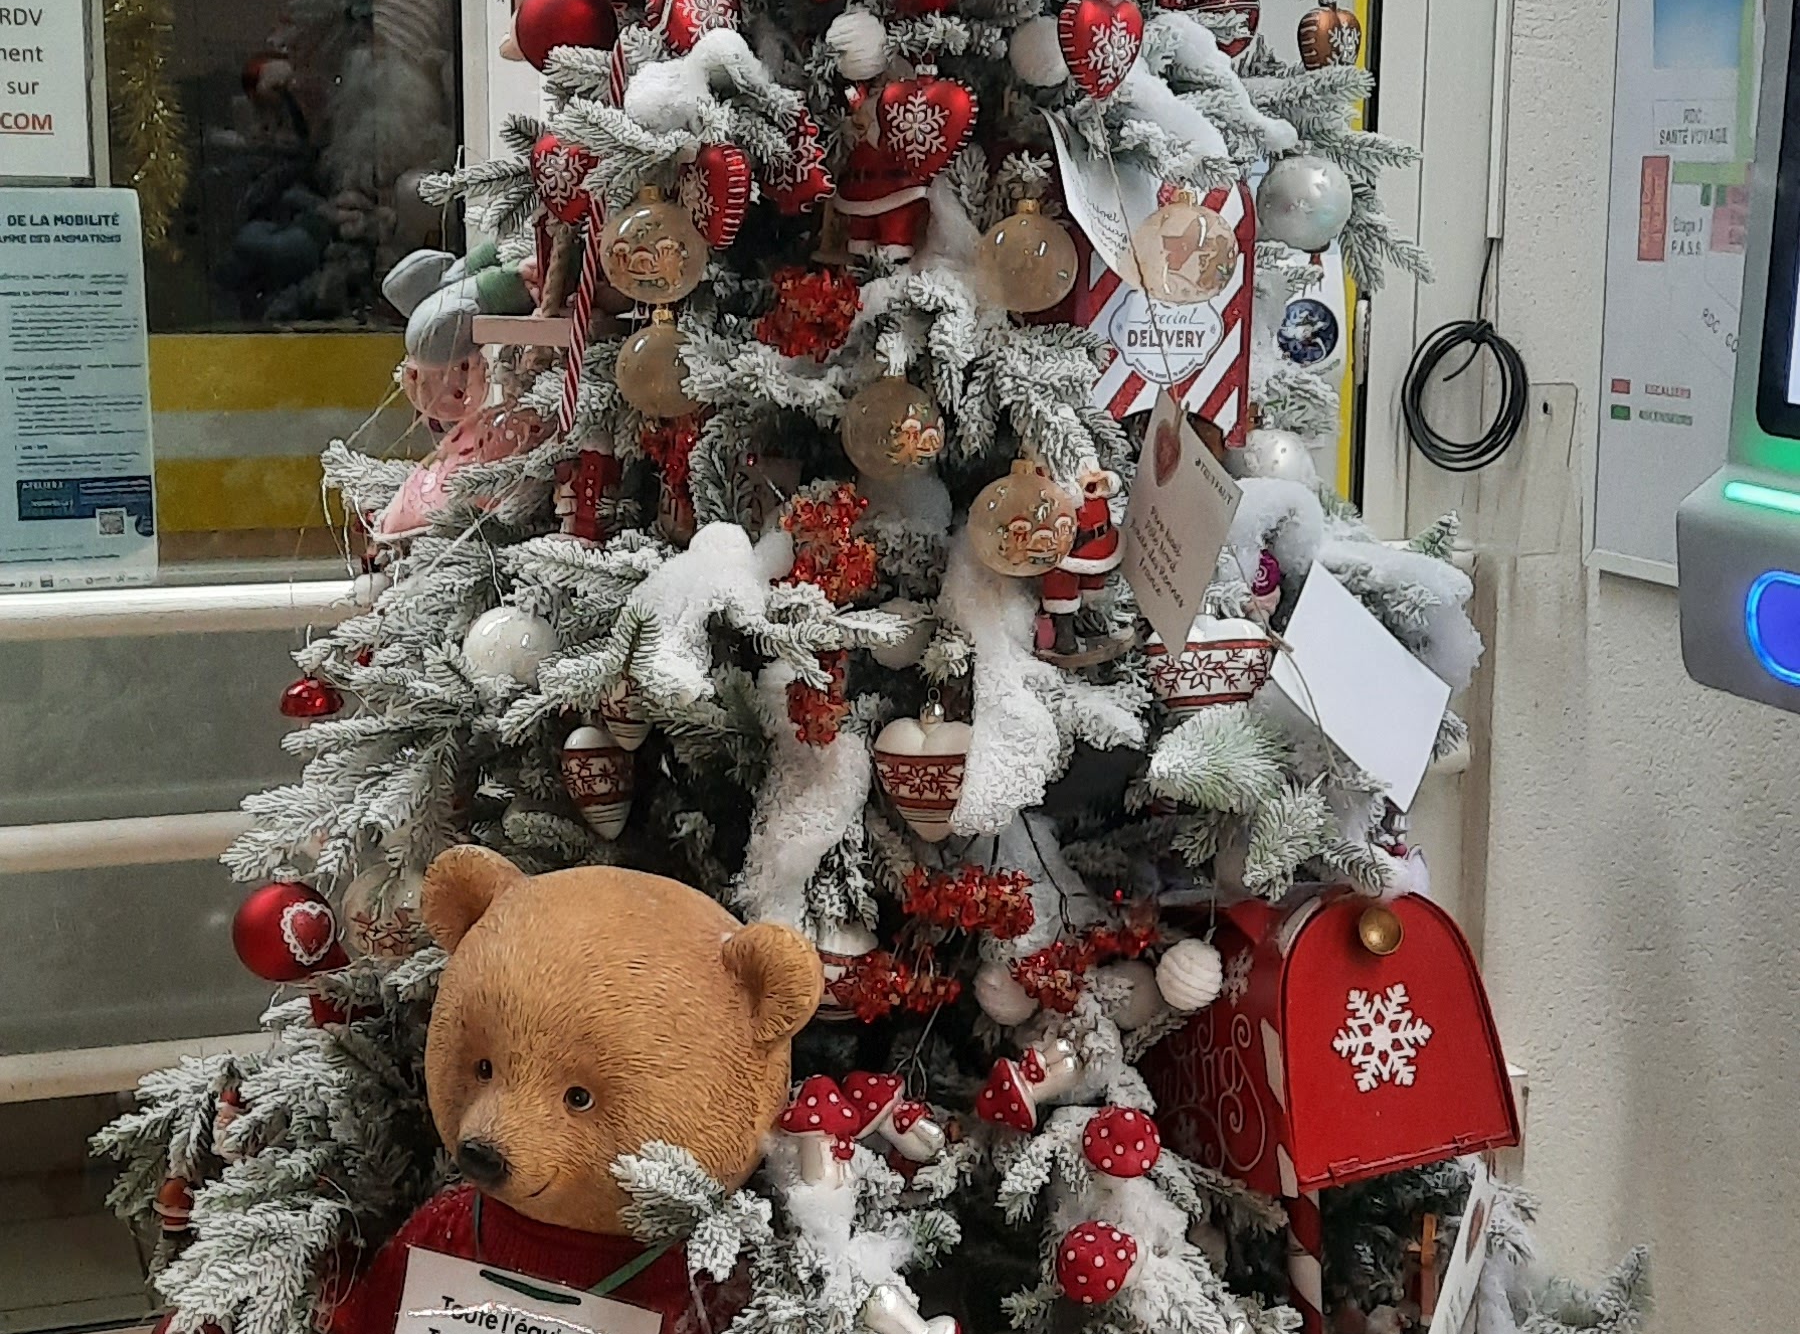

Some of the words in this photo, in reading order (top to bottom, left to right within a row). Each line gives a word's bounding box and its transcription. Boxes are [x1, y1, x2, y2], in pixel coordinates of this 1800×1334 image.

[0, 8, 43, 26] RDV
[7, 81, 39, 95] sur
[7, 214, 26, 227] DE
[30, 214, 50, 227] LA
[53, 212, 120, 227] MOBILITÉ
[1127, 329, 1206, 348] DELIVERY
[441, 1295, 498, 1330] Toute
